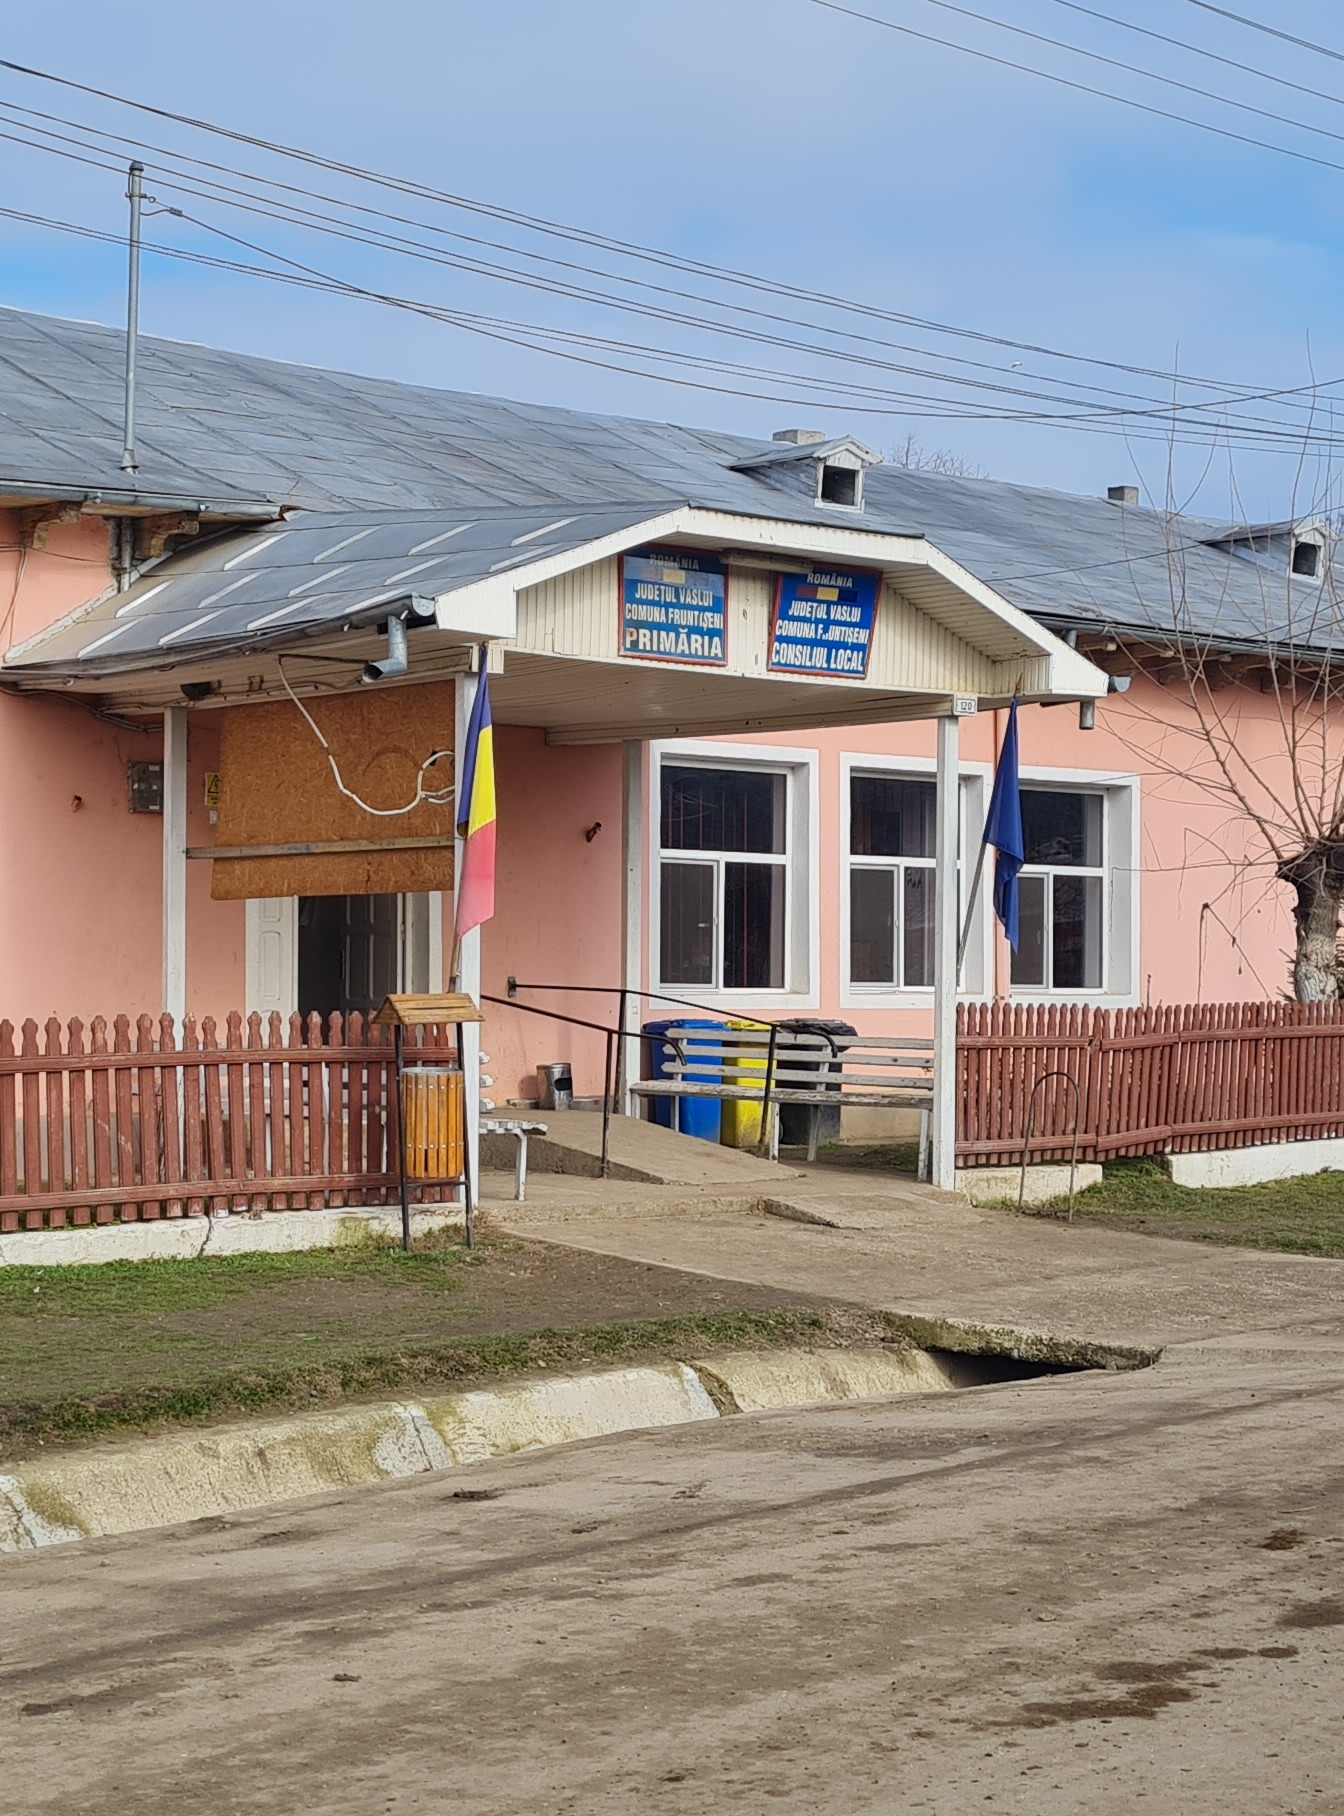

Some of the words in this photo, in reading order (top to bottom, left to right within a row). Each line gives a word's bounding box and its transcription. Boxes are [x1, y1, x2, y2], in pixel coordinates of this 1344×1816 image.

[806, 572, 854, 588] ROMÂNIA
[634, 582, 678, 605] JUDEȚUL
[679, 587, 713, 607] VASLUI
[625, 603, 666, 624] COMUNA
[668, 607, 724, 632] FRUNTIȘENI
[788, 600, 827, 621] JUDEȚUL
[830, 604, 862, 623] VASLUI
[775, 619, 816, 640] COMUNA
[625, 627, 723, 658] PRIMĂRIA
[771, 641, 828, 669] CONSILIUL
[829, 648, 864, 672] LOCAL
